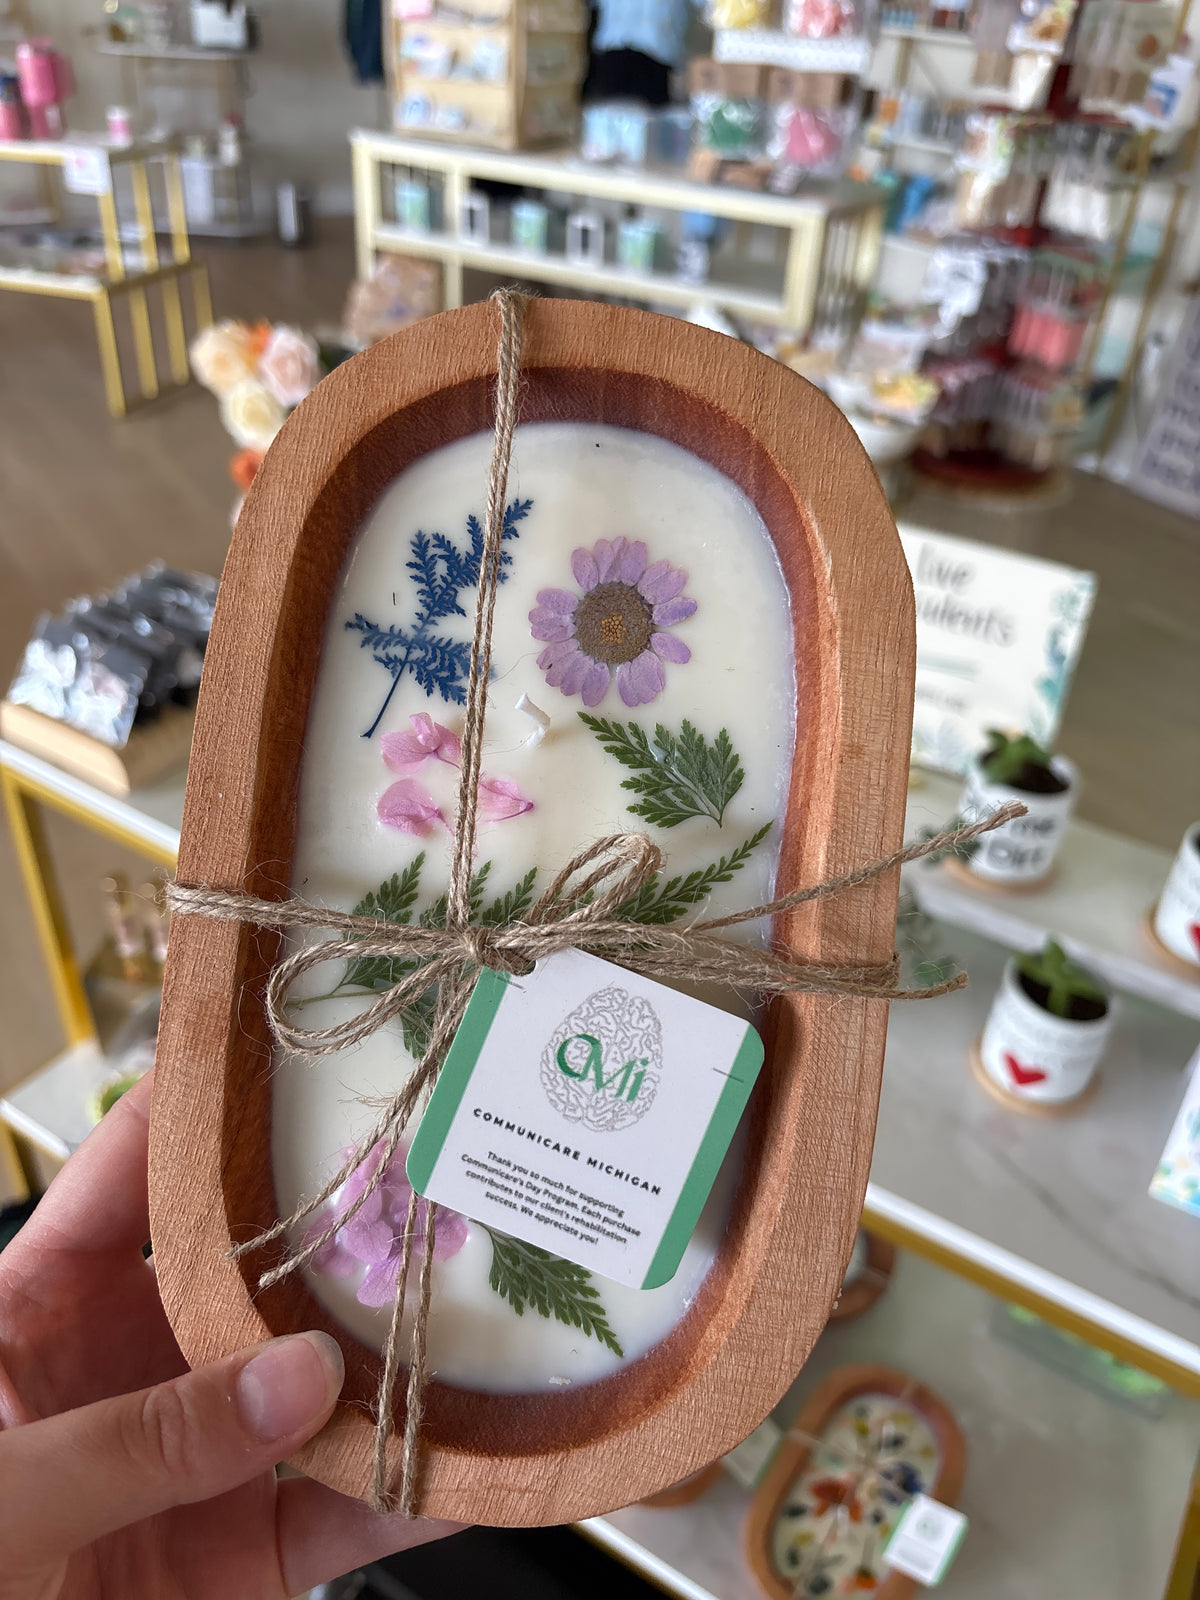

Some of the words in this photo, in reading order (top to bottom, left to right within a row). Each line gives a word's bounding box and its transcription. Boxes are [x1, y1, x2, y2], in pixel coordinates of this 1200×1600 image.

[473, 1107, 580, 1160] COMMUNICARE
[587, 1157, 661, 1195] MICHIGAN
[488, 1151, 512, 1168] Thank
[512, 1164, 529, 1175] you
[530, 1171, 540, 1180] so
[541, 1176, 564, 1190] much
[565, 1185, 578, 1196] for
[579, 1192, 625, 1218] supporting
[461, 1154, 524, 1186] Communicare's
[525, 1181, 542, 1195] Day
[543, 1188, 579, 1210] Program.
[581, 1205, 602, 1219] Each
[602, 1215, 641, 1237] purchase
[466, 1170, 513, 1195] contributes
[514, 1190, 524, 1199] to
[524, 1195, 540, 1205] our
[540, 1202, 570, 1219] client's
[570, 1215, 627, 1244] rehabilitation
[485, 1191, 518, 1210] success.
[520, 1204, 534, 1217] We
[534, 1212, 579, 1237] appreciate
[579, 1232, 599, 1245] you!
